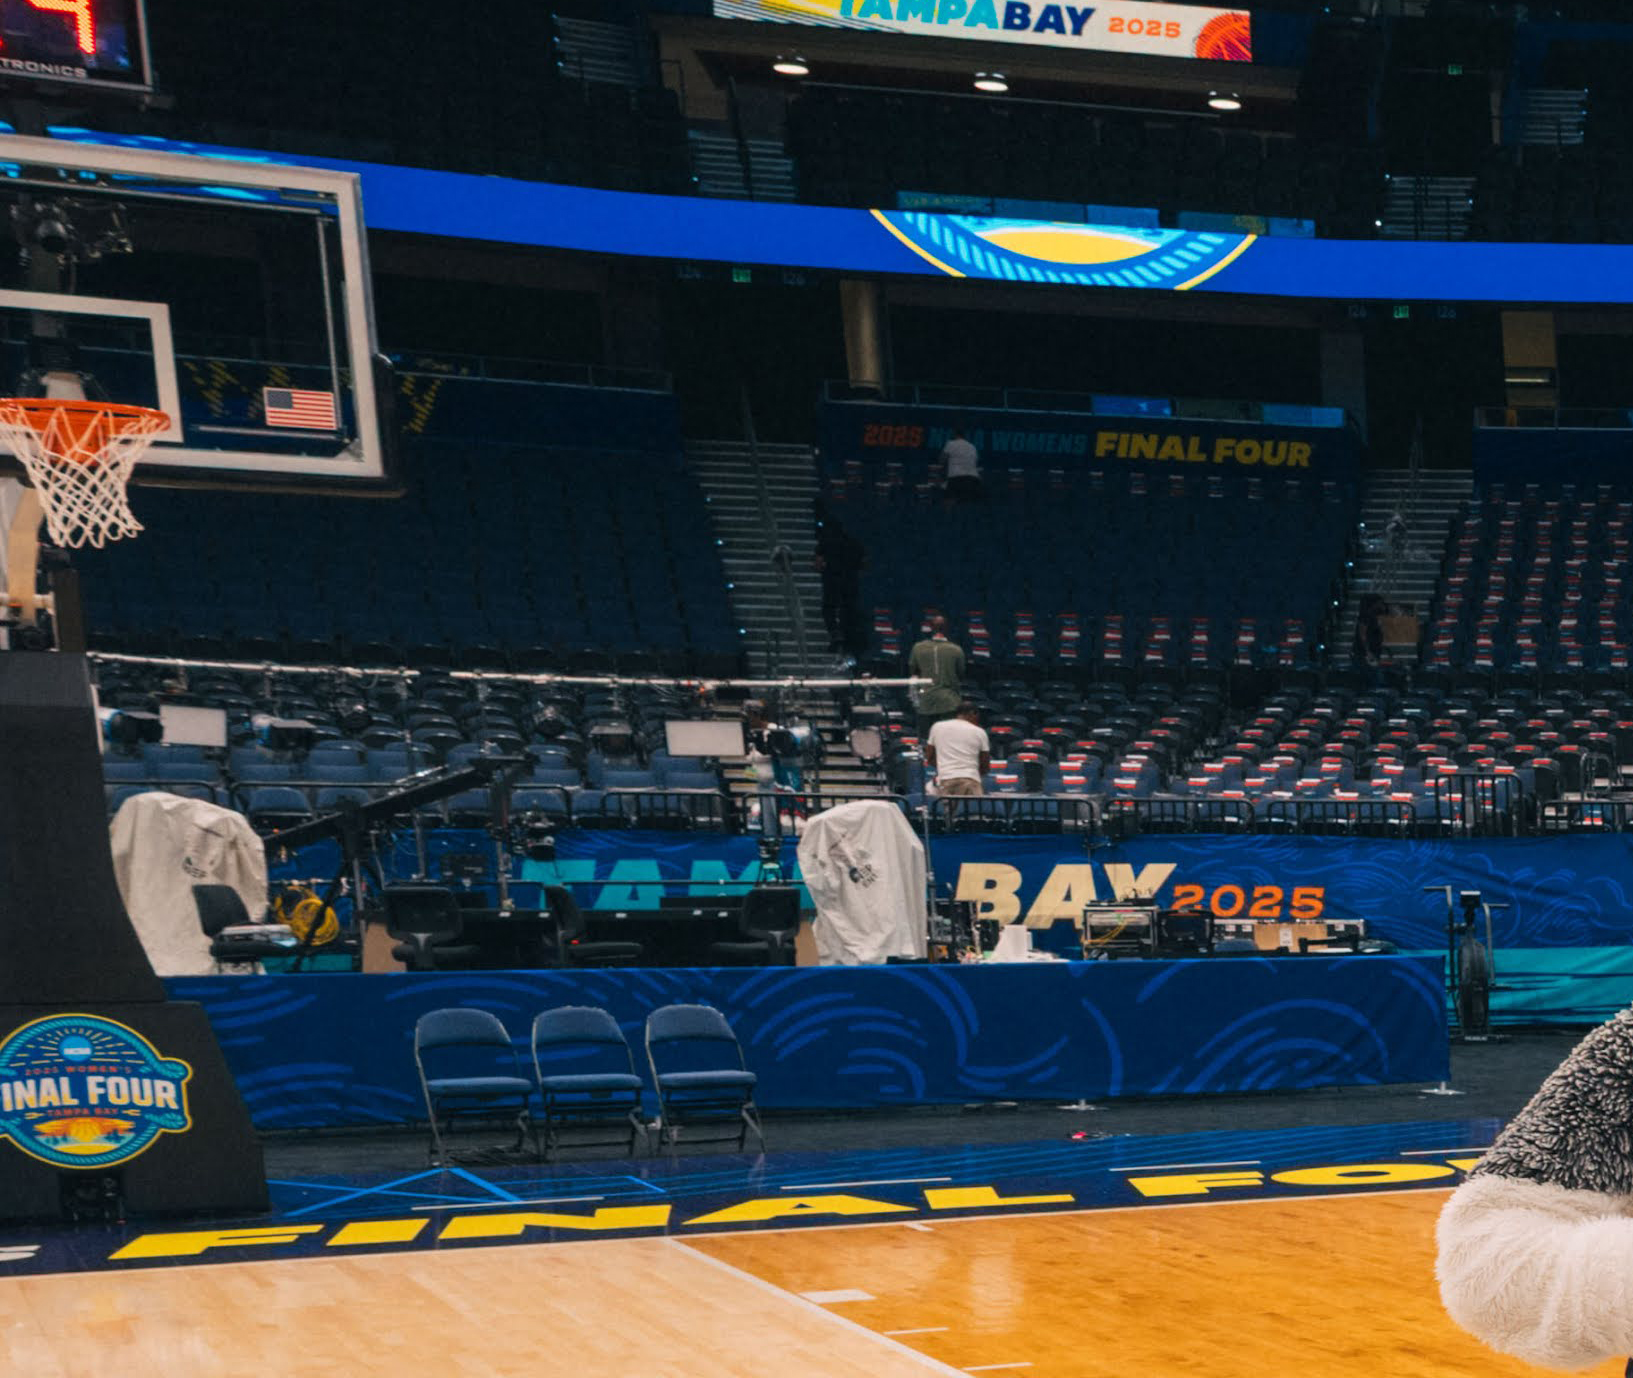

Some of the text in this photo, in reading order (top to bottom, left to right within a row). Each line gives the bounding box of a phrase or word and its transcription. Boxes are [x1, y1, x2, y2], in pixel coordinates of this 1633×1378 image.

[1002, 1, 1096, 36] BAY
[1108, 17, 1181, 38] 2025
[864, 424, 922, 448] 2025
[992, 430, 1088, 454] WOMENS
[1095, 431, 1206, 462] FINAL
[1212, 438, 1312, 468] FOUR
[956, 863, 1177, 930] BAY
[1171, 884, 1325, 918] 2025
[86, 1076, 179, 1110] FOUR
[1128, 1157, 1490, 1198] FO
[108, 1185, 1076, 1261] FINAL
